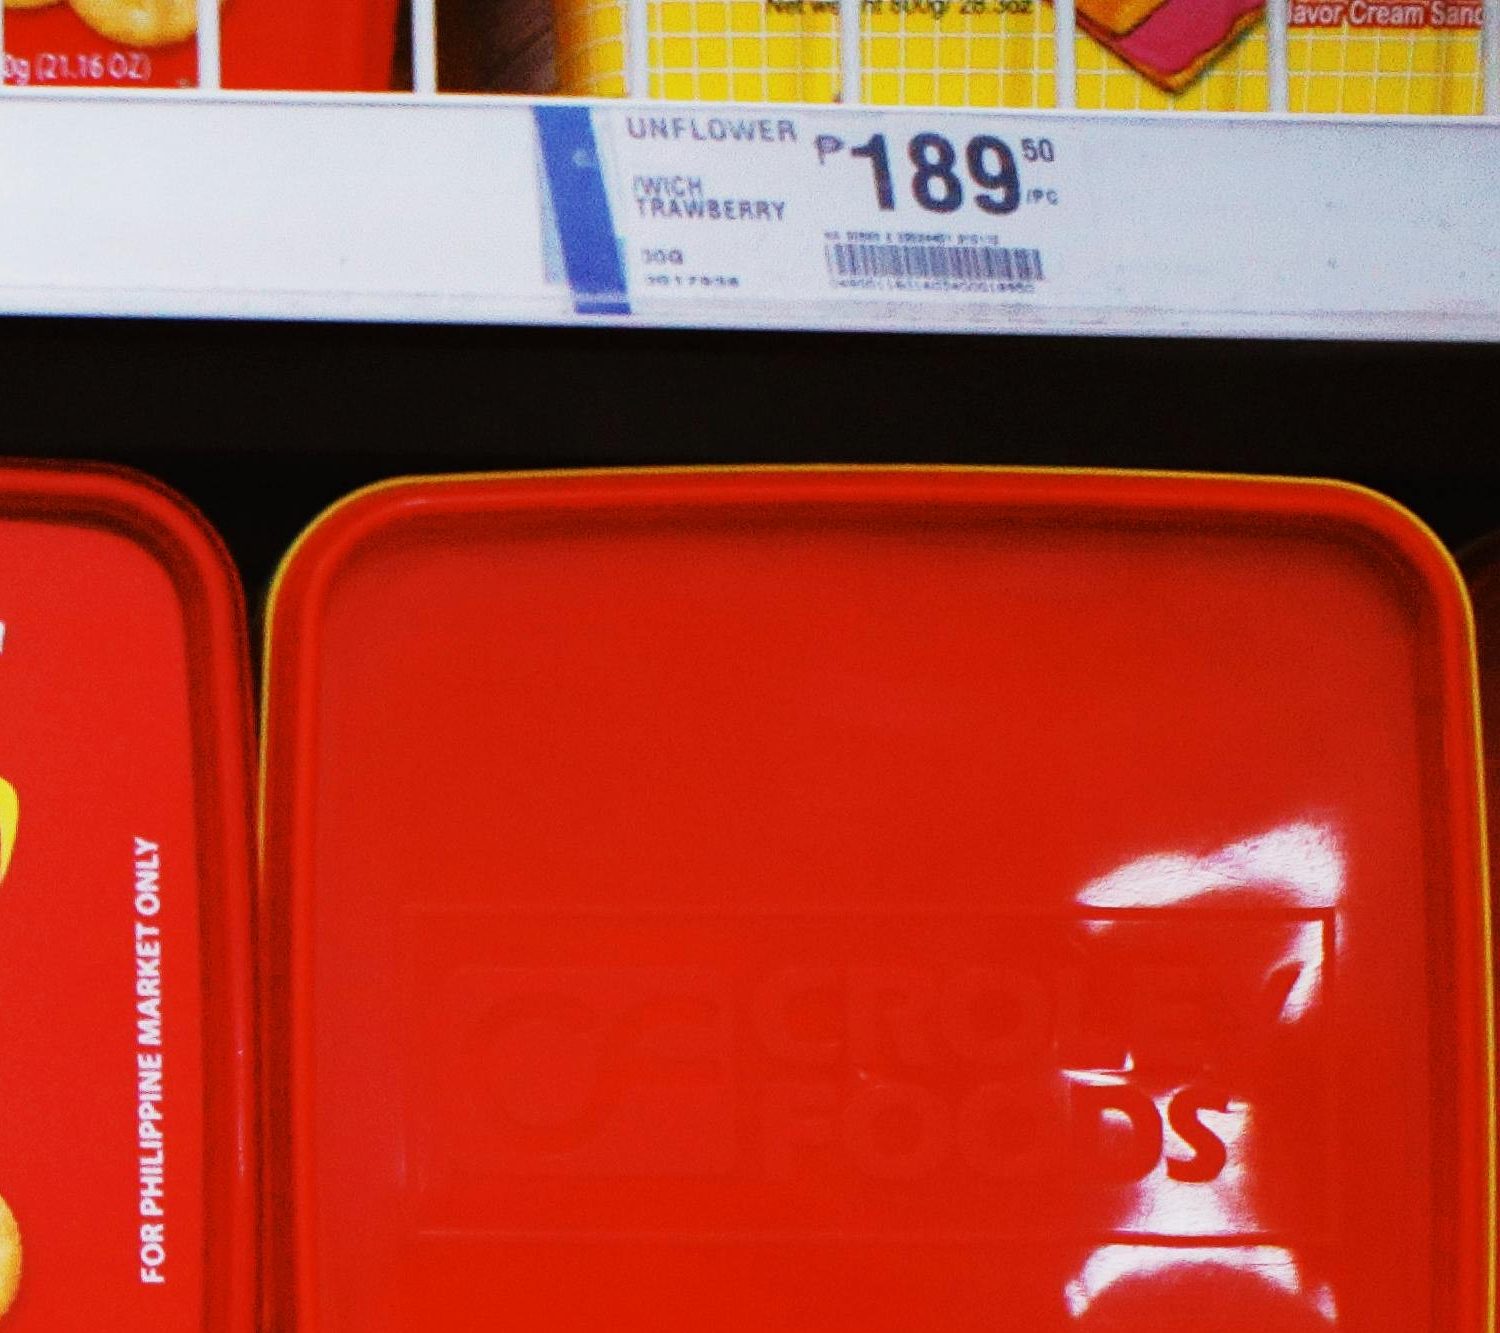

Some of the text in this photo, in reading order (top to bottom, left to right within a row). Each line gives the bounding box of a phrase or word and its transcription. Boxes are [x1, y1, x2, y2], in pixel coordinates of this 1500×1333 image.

[1349, 1, 1427, 29] Cream
[107, 52, 151, 81] OZ)
[1021, 138, 1054, 162] 50
